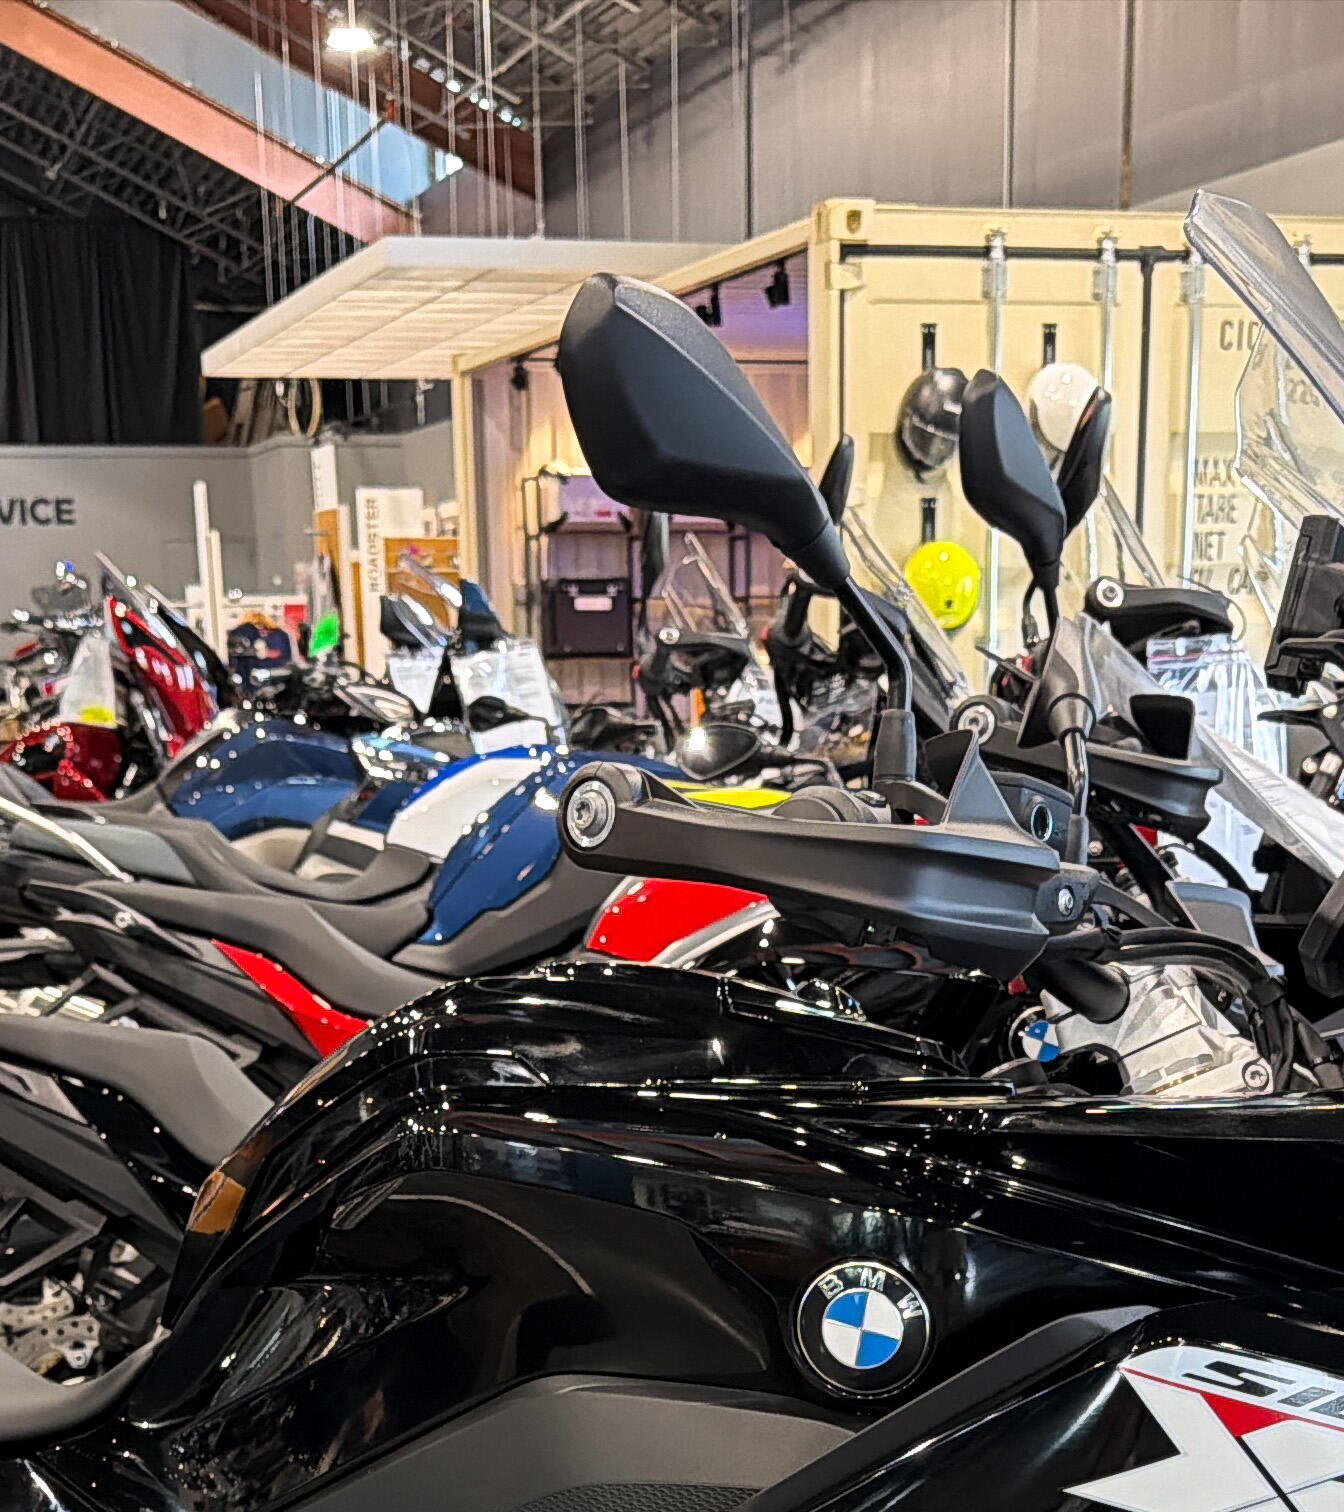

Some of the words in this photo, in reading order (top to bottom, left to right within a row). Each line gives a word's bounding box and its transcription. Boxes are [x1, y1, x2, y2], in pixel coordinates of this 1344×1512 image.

[1196, 494, 1239, 525] TARE
[365, 498, 383, 593] ROADSTER
[818, 1267, 923, 1320] BMW
